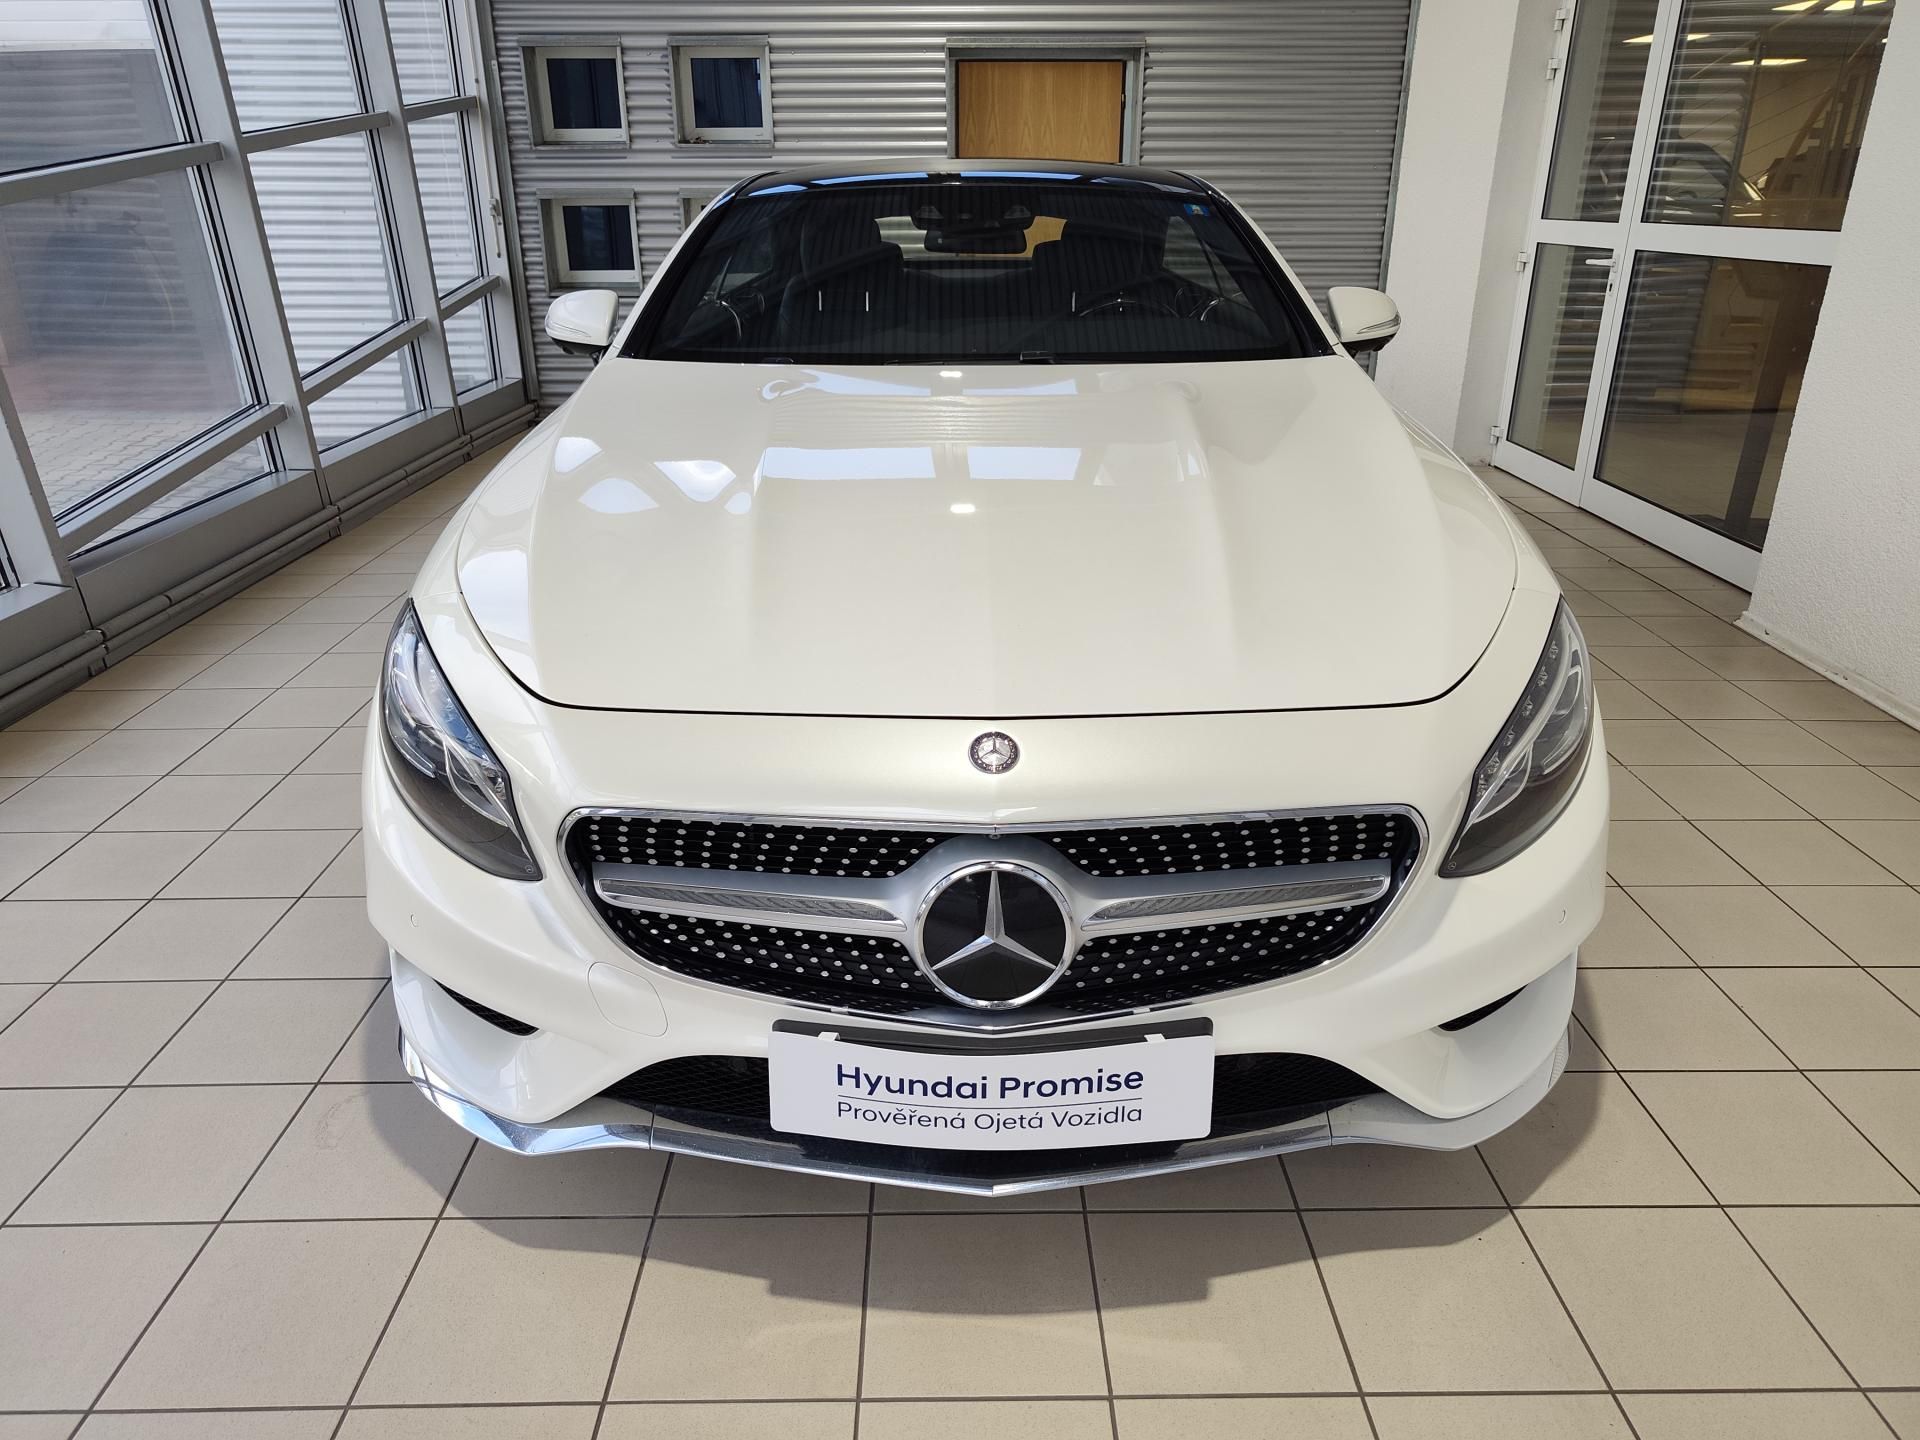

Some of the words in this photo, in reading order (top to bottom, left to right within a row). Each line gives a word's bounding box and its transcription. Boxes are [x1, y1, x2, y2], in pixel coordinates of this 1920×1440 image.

[837, 1064, 988, 1100] Hyundai
[1000, 1068, 1144, 1100] Promise
[838, 1101, 966, 1130] Prověřená
[974, 1112, 1043, 1134] Ojetá
[1051, 1105, 1143, 1128] Vozidla
